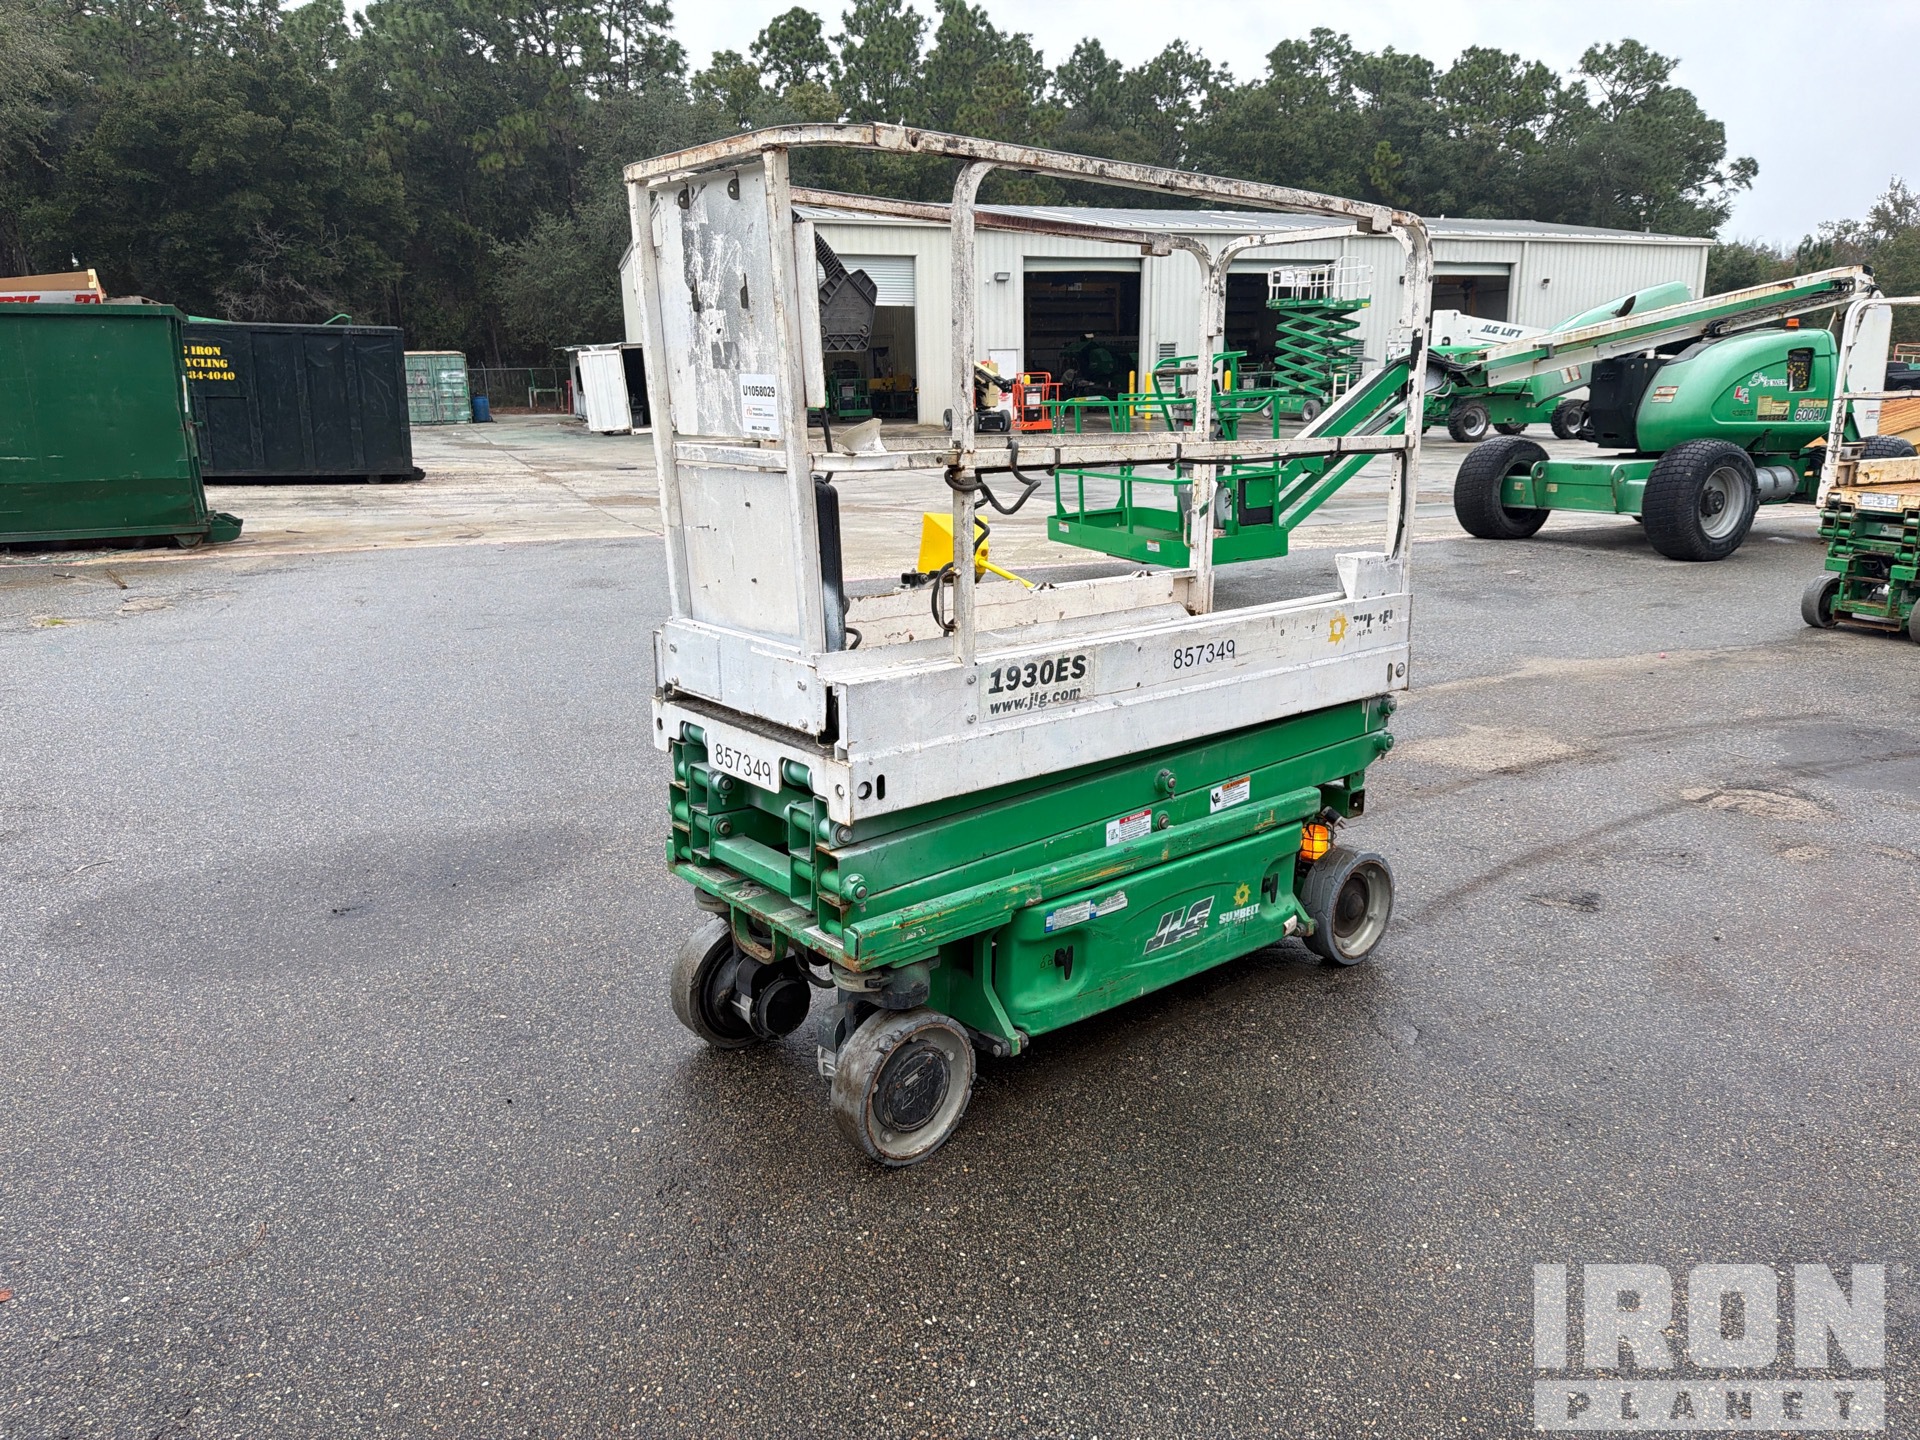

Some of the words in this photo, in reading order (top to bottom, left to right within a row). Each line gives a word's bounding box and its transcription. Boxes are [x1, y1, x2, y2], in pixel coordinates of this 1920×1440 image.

[1480, 324, 1500, 335] JLG
[1500, 327, 1523, 338] LIFT
[191, 346, 221, 355] IRON
[187, 371, 236, 380] 84-4040
[743, 385, 775, 397] U1058029
[1794, 408, 1827, 422] 600AJ
[1173, 639, 1236, 670] 857349
[988, 654, 1087, 694] 1930ES
[715, 743, 772, 785] 857349
